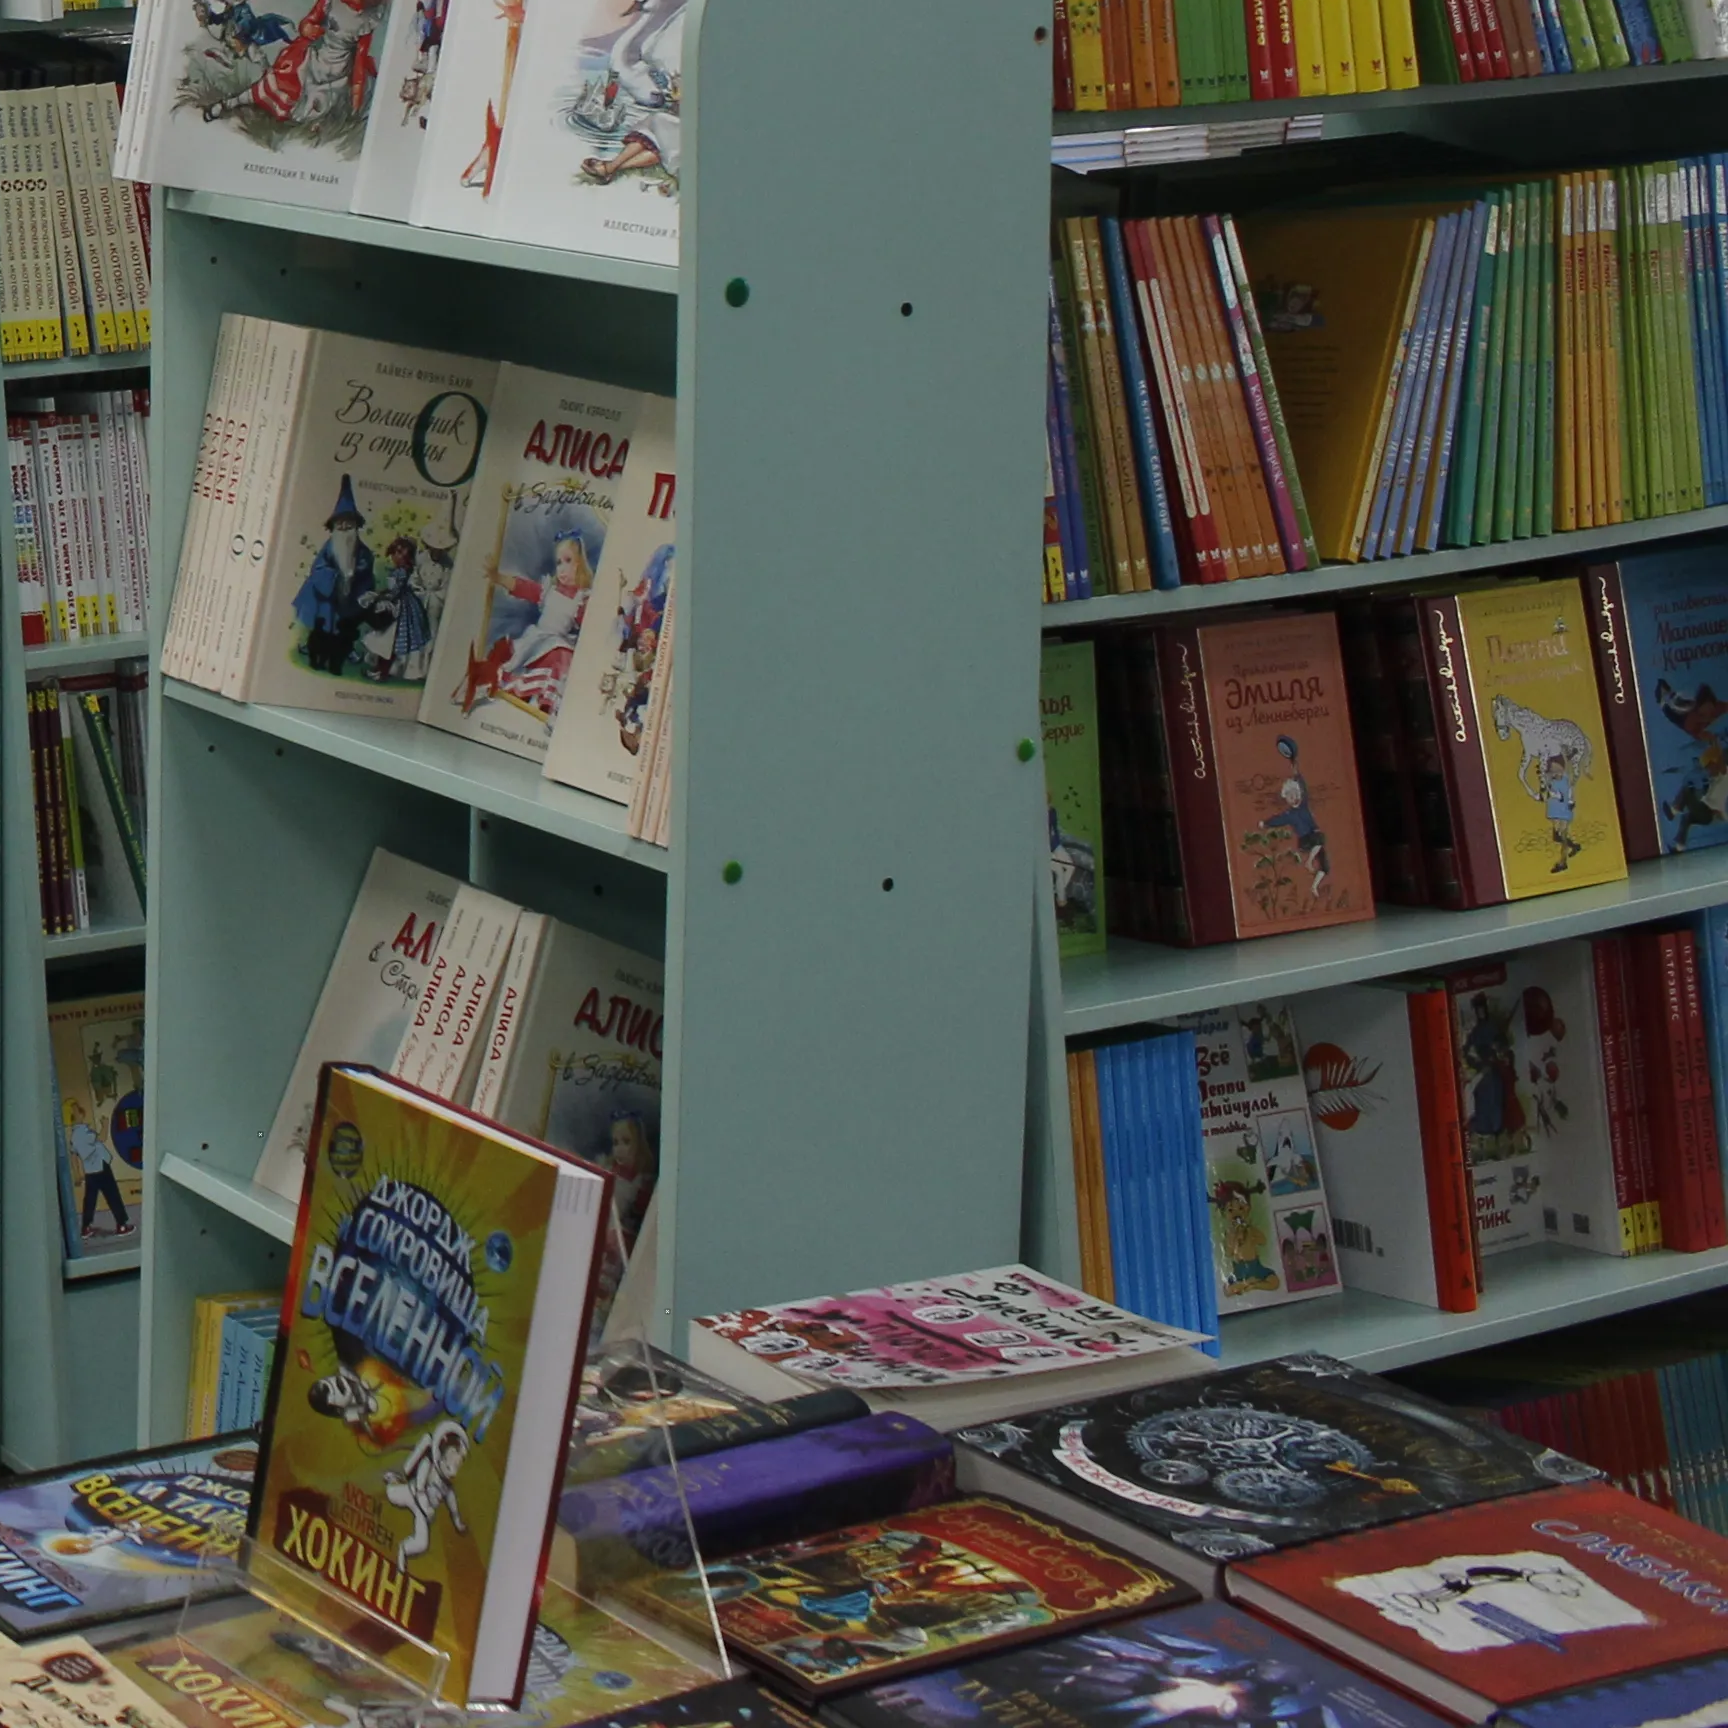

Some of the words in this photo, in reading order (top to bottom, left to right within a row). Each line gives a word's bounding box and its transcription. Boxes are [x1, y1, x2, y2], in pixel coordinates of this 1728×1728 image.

[56, 190, 71, 239] ПОЛНЫЙ
[79, 188, 93, 237] ПОЛНЫЙ
[100, 187, 115, 236] ПОЛНЫЙ
[120, 185, 136, 234] ПОЛНЫЙ
[203, 415, 224, 500] СКАЗКИ
[214, 418, 236, 503] СКАЗКИ
[225, 421, 249, 506] СКАЗКИ
[521, 418, 631, 480] АЛИСА
[1224, 675, 1325, 711] Эмиля
[1225, 718, 1245, 733] из
[413, 954, 449, 1031] АЛИСА
[432, 964, 468, 1040] АЛИСА
[451, 971, 489, 1047] АЛИСА
[492, 985, 519, 1063] АЛИСА
[1194, 1042, 1231, 1077] Всё
[367, 1172, 476, 1273] ДЖОРДЖ
[352, 1208, 490, 1342] СОКРОВИЩА
[300, 1242, 506, 1445] ВСЕЛЕННОЙ
[282, 1502, 428, 1631] ХОКИНГ
